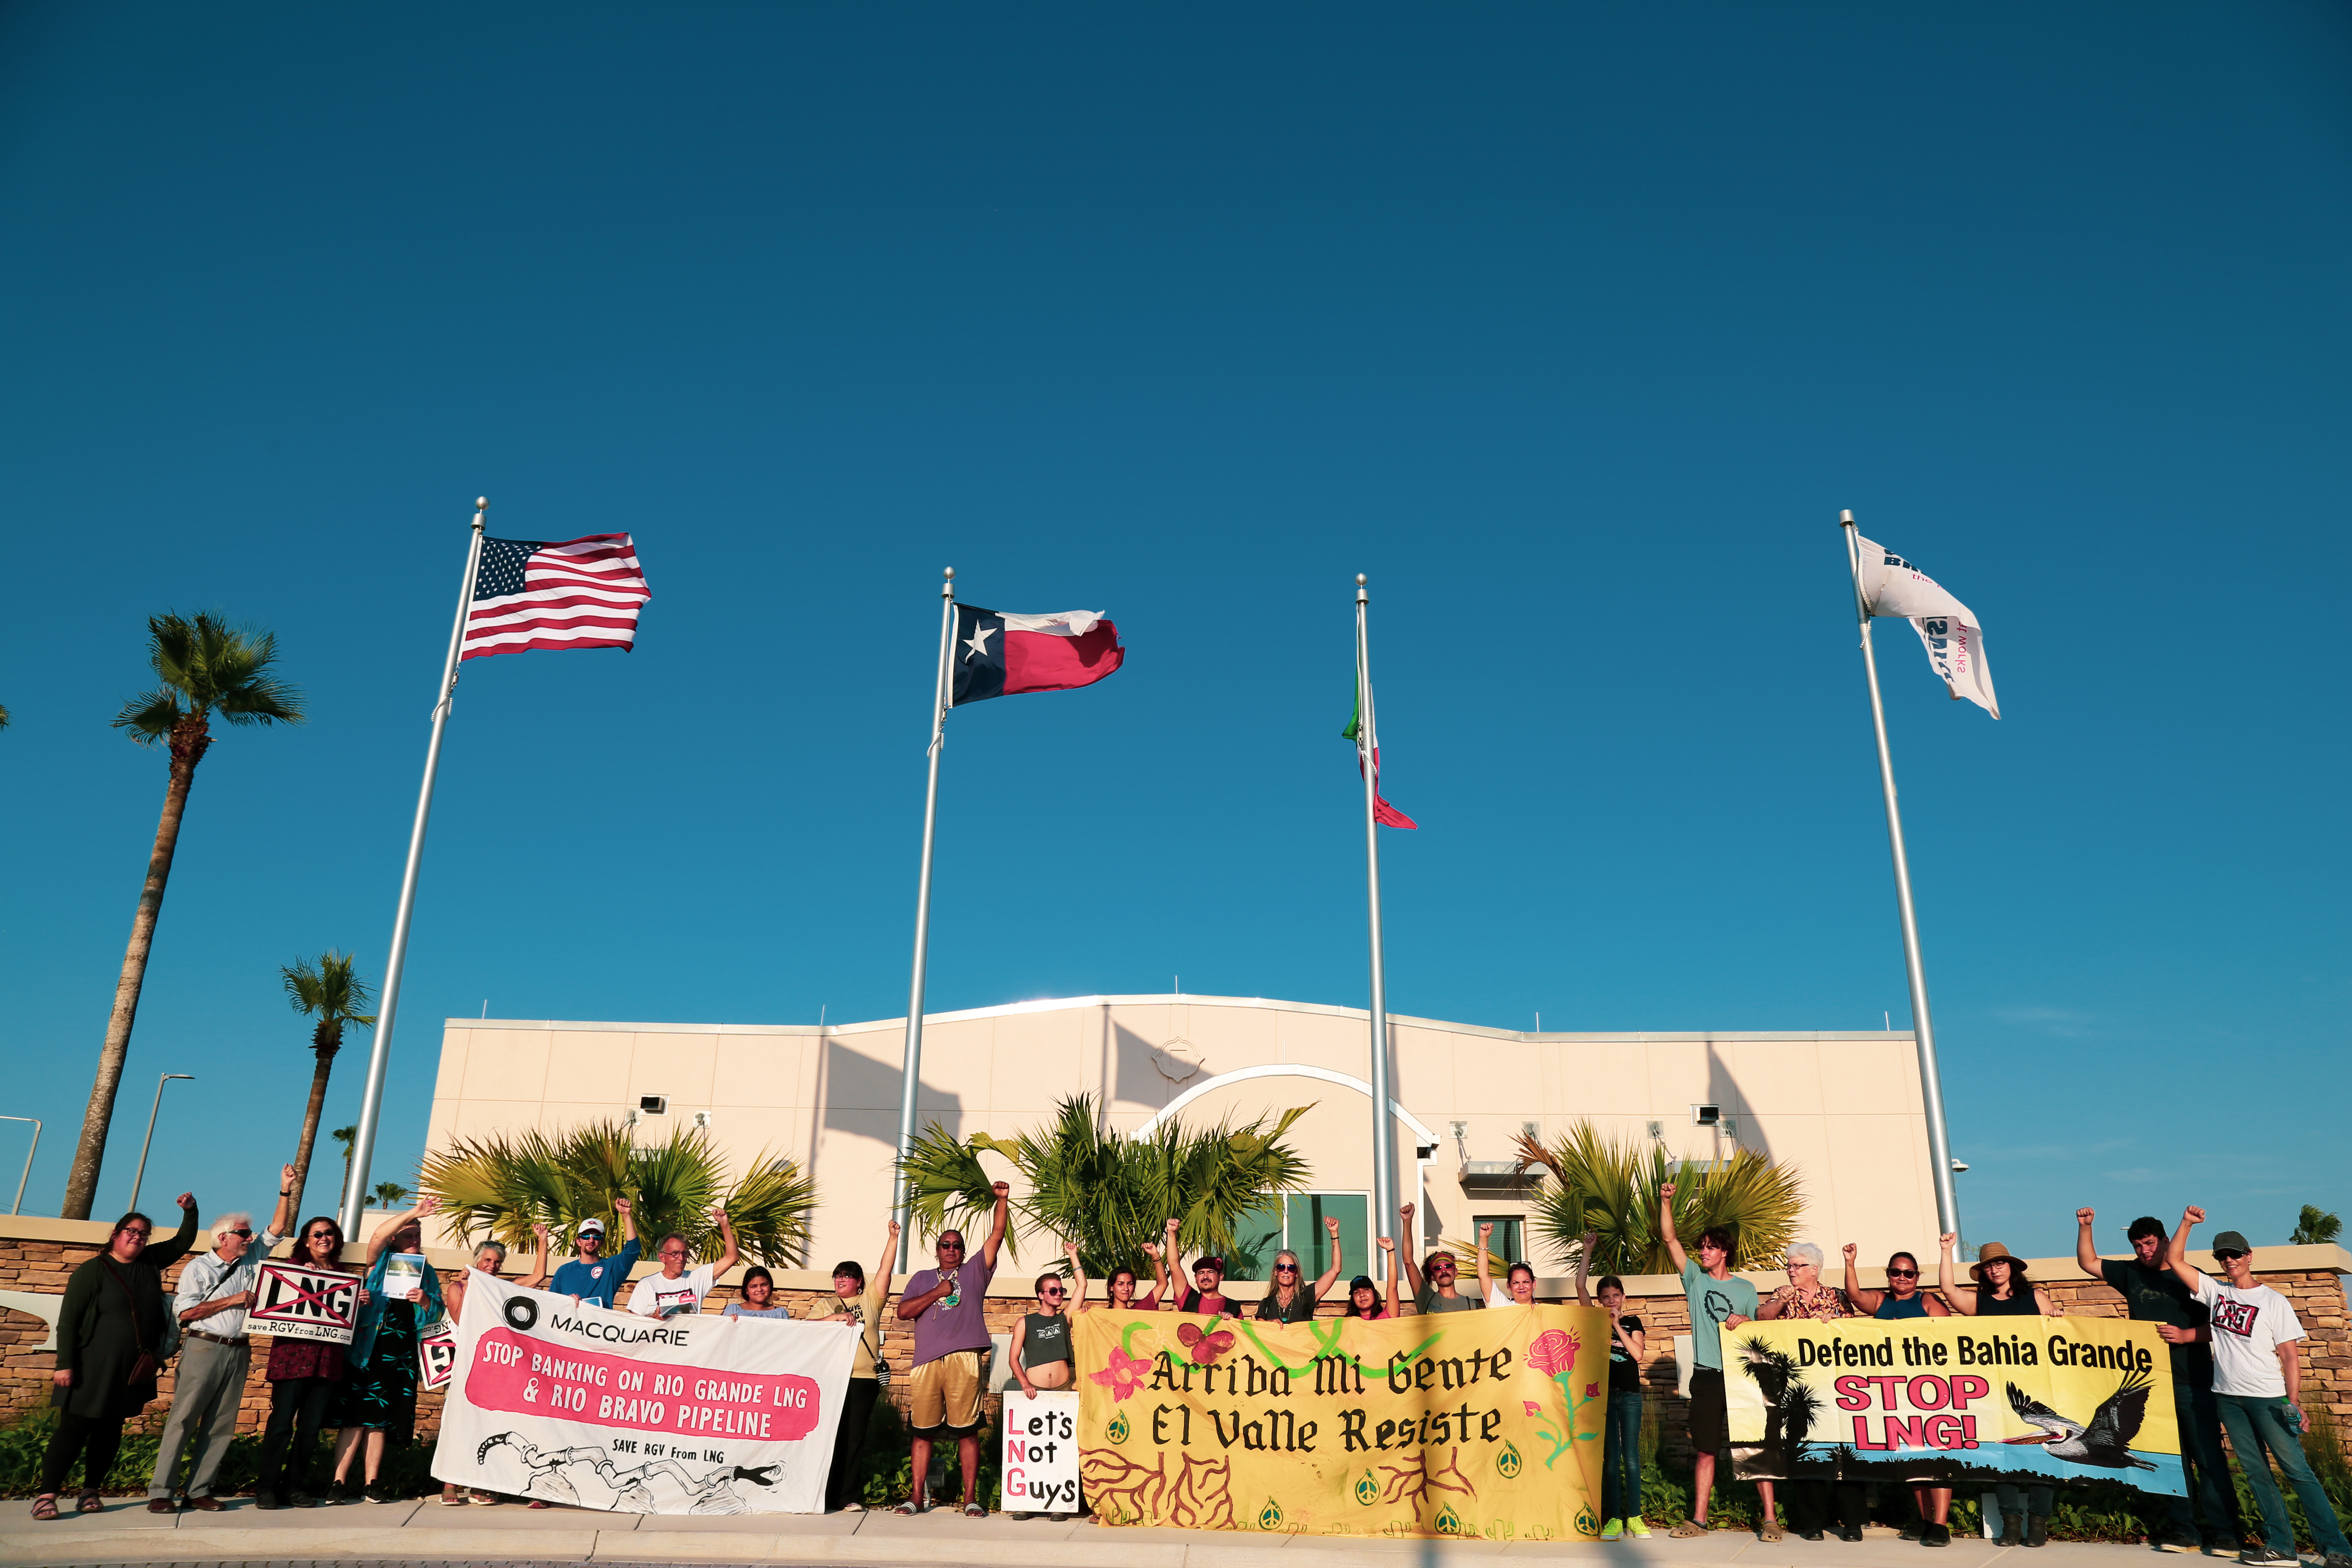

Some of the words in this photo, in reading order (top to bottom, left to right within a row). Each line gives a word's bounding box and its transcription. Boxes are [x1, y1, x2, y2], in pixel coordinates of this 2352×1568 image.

[265, 1272, 352, 1320] LNG
[550, 1314, 690, 1346] MACQUARIE
[1147, 1350, 1293, 1397] Arriba
[1309, 1353, 1365, 1396] Mi
[1388, 1347, 1512, 1394] Gente
[1798, 1336, 1894, 1367] Defend
[1902, 1336, 1948, 1366] the
[1957, 1334, 2038, 1365] Bahia
[2048, 1335, 2153, 1373] Grande
[482, 1341, 524, 1368] STOP
[531, 1353, 608, 1387] BANKING
[618, 1370, 644, 1392] ON
[653, 1374, 684, 1397] RIO
[695, 1379, 764, 1403] GRANDE
[773, 1386, 808, 1409] LNG
[1834, 1374, 1989, 1411] STOP
[523, 1377, 539, 1403] &
[550, 1384, 586, 1412] RIO
[598, 1395, 665, 1424] BRAVO
[677, 1404, 771, 1438] PIPELINE
[1009, 1409, 1072, 1440] Let's
[1152, 1403, 1191, 1446] El
[1207, 1409, 1318, 1453] Valle
[1337, 1401, 1501, 1452] Resiste
[612, 1439, 638, 1454] SAVE
[644, 1443, 666, 1456] RGV
[670, 1447, 697, 1460] From
[704, 1449, 724, 1463] LNG
[1008, 1440, 1058, 1463] Not
[1852, 1414, 1980, 1451] LNG!
[1007, 1467, 1076, 1510] Guys
